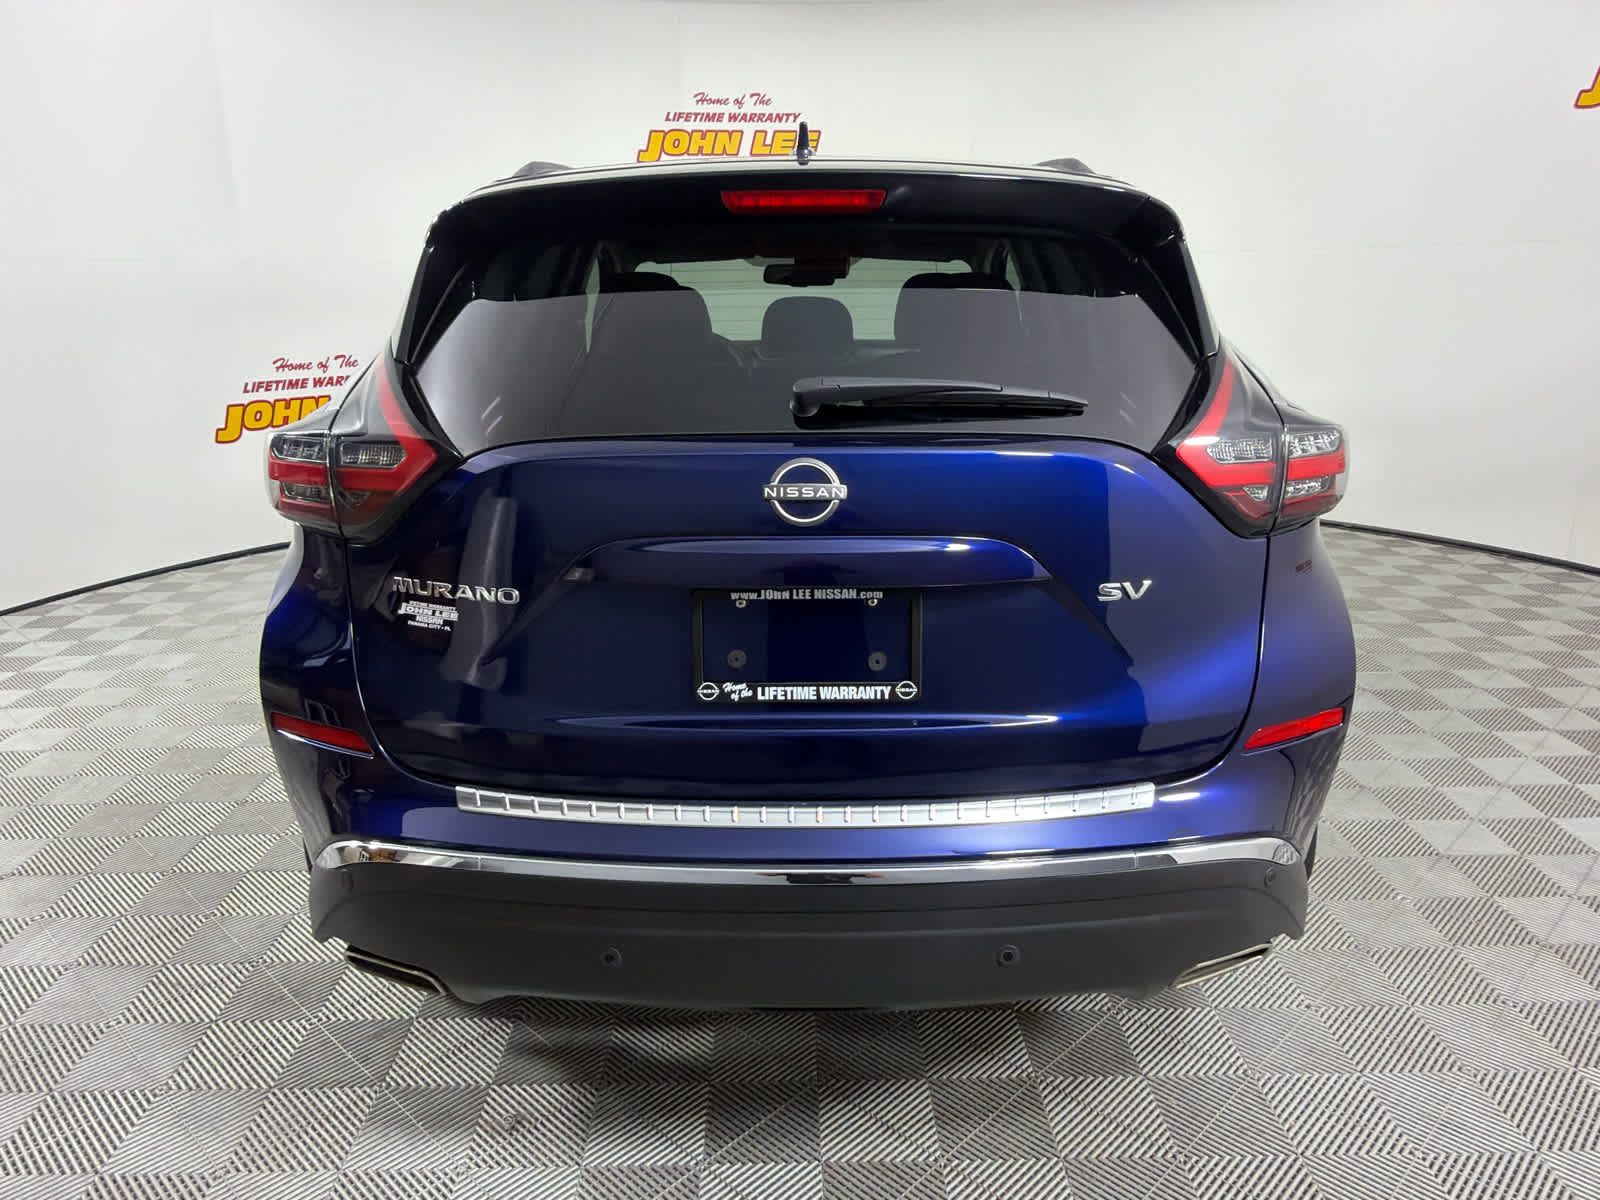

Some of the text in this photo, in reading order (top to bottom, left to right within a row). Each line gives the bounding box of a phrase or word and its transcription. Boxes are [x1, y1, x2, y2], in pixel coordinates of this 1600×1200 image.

[692, 92, 773, 109] Home of The
[664, 111, 801, 124] LIFETIME WARRANTY
[636, 128, 744, 163] JOHN
[272, 354, 360, 374] Home of The
[242, 378, 310, 394] LIFETIME
[763, 486, 844, 498] NISSAN
[392, 575, 520, 605] MURANO
[792, 588, 812, 600] LEE
[1097, 579, 1152, 602] SV
[757, 686, 892, 700] LIFETIME WARRANTY
